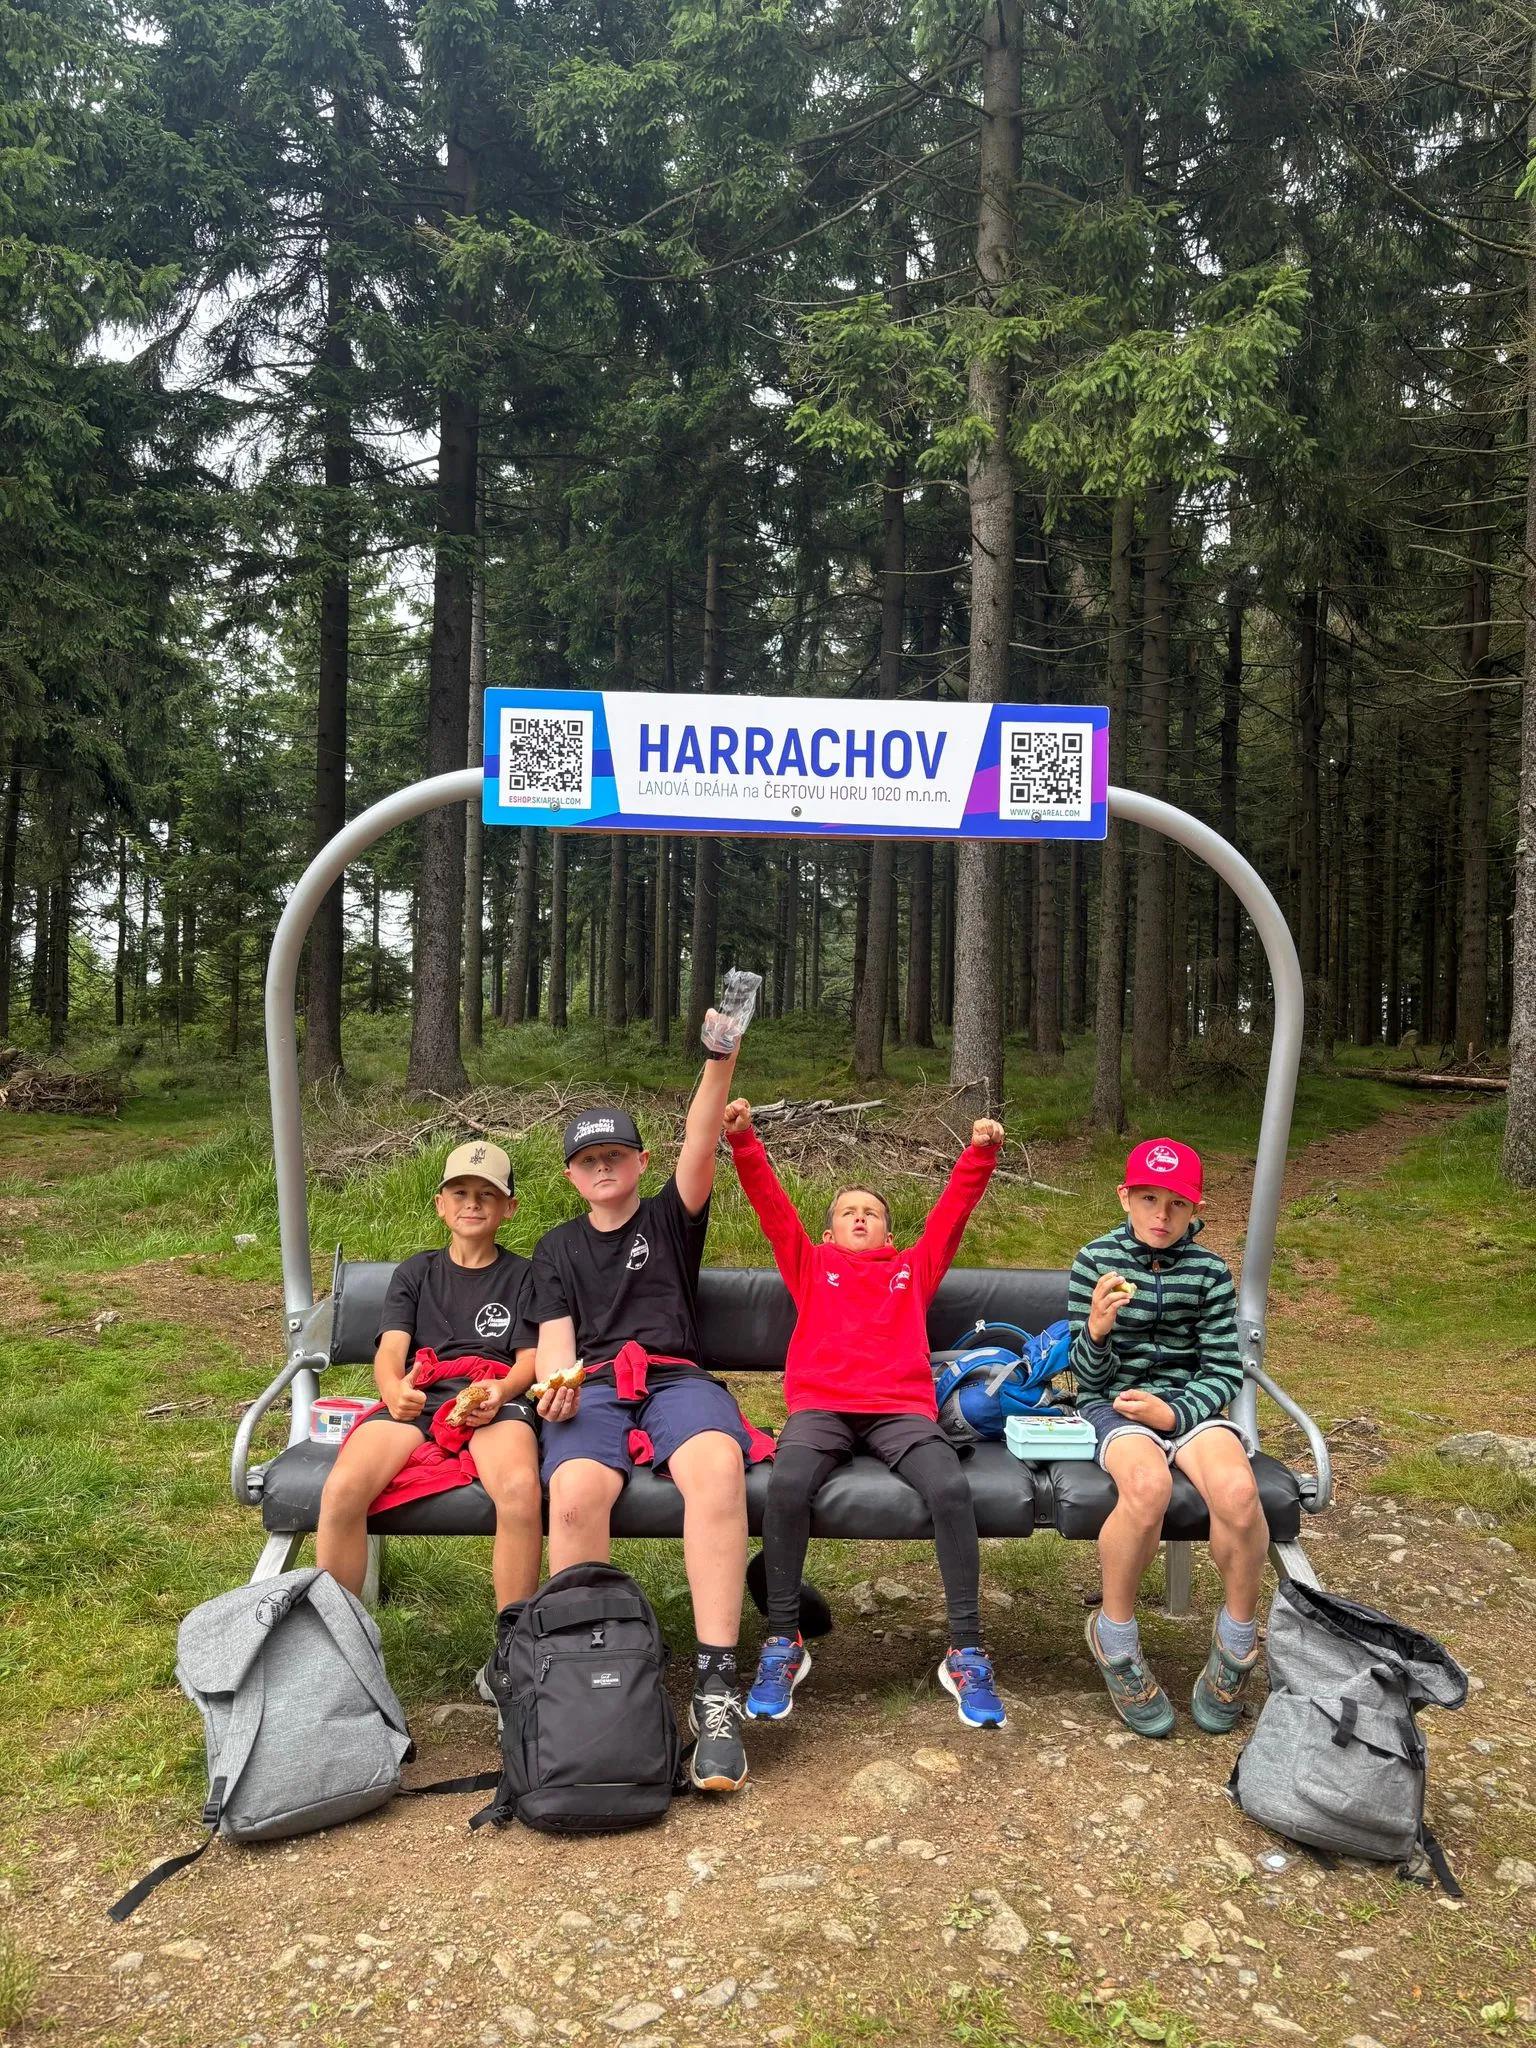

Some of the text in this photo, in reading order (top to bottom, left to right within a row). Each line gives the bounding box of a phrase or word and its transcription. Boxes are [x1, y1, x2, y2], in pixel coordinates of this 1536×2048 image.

[640, 723, 947, 779] HARRACHOV
[638, 779, 951, 802] LANOVÁ DRÁHA na ČERTOVU HORU 1020 m.n.m.
[1010, 808, 1080, 817] WWW.IAREAL.COM
